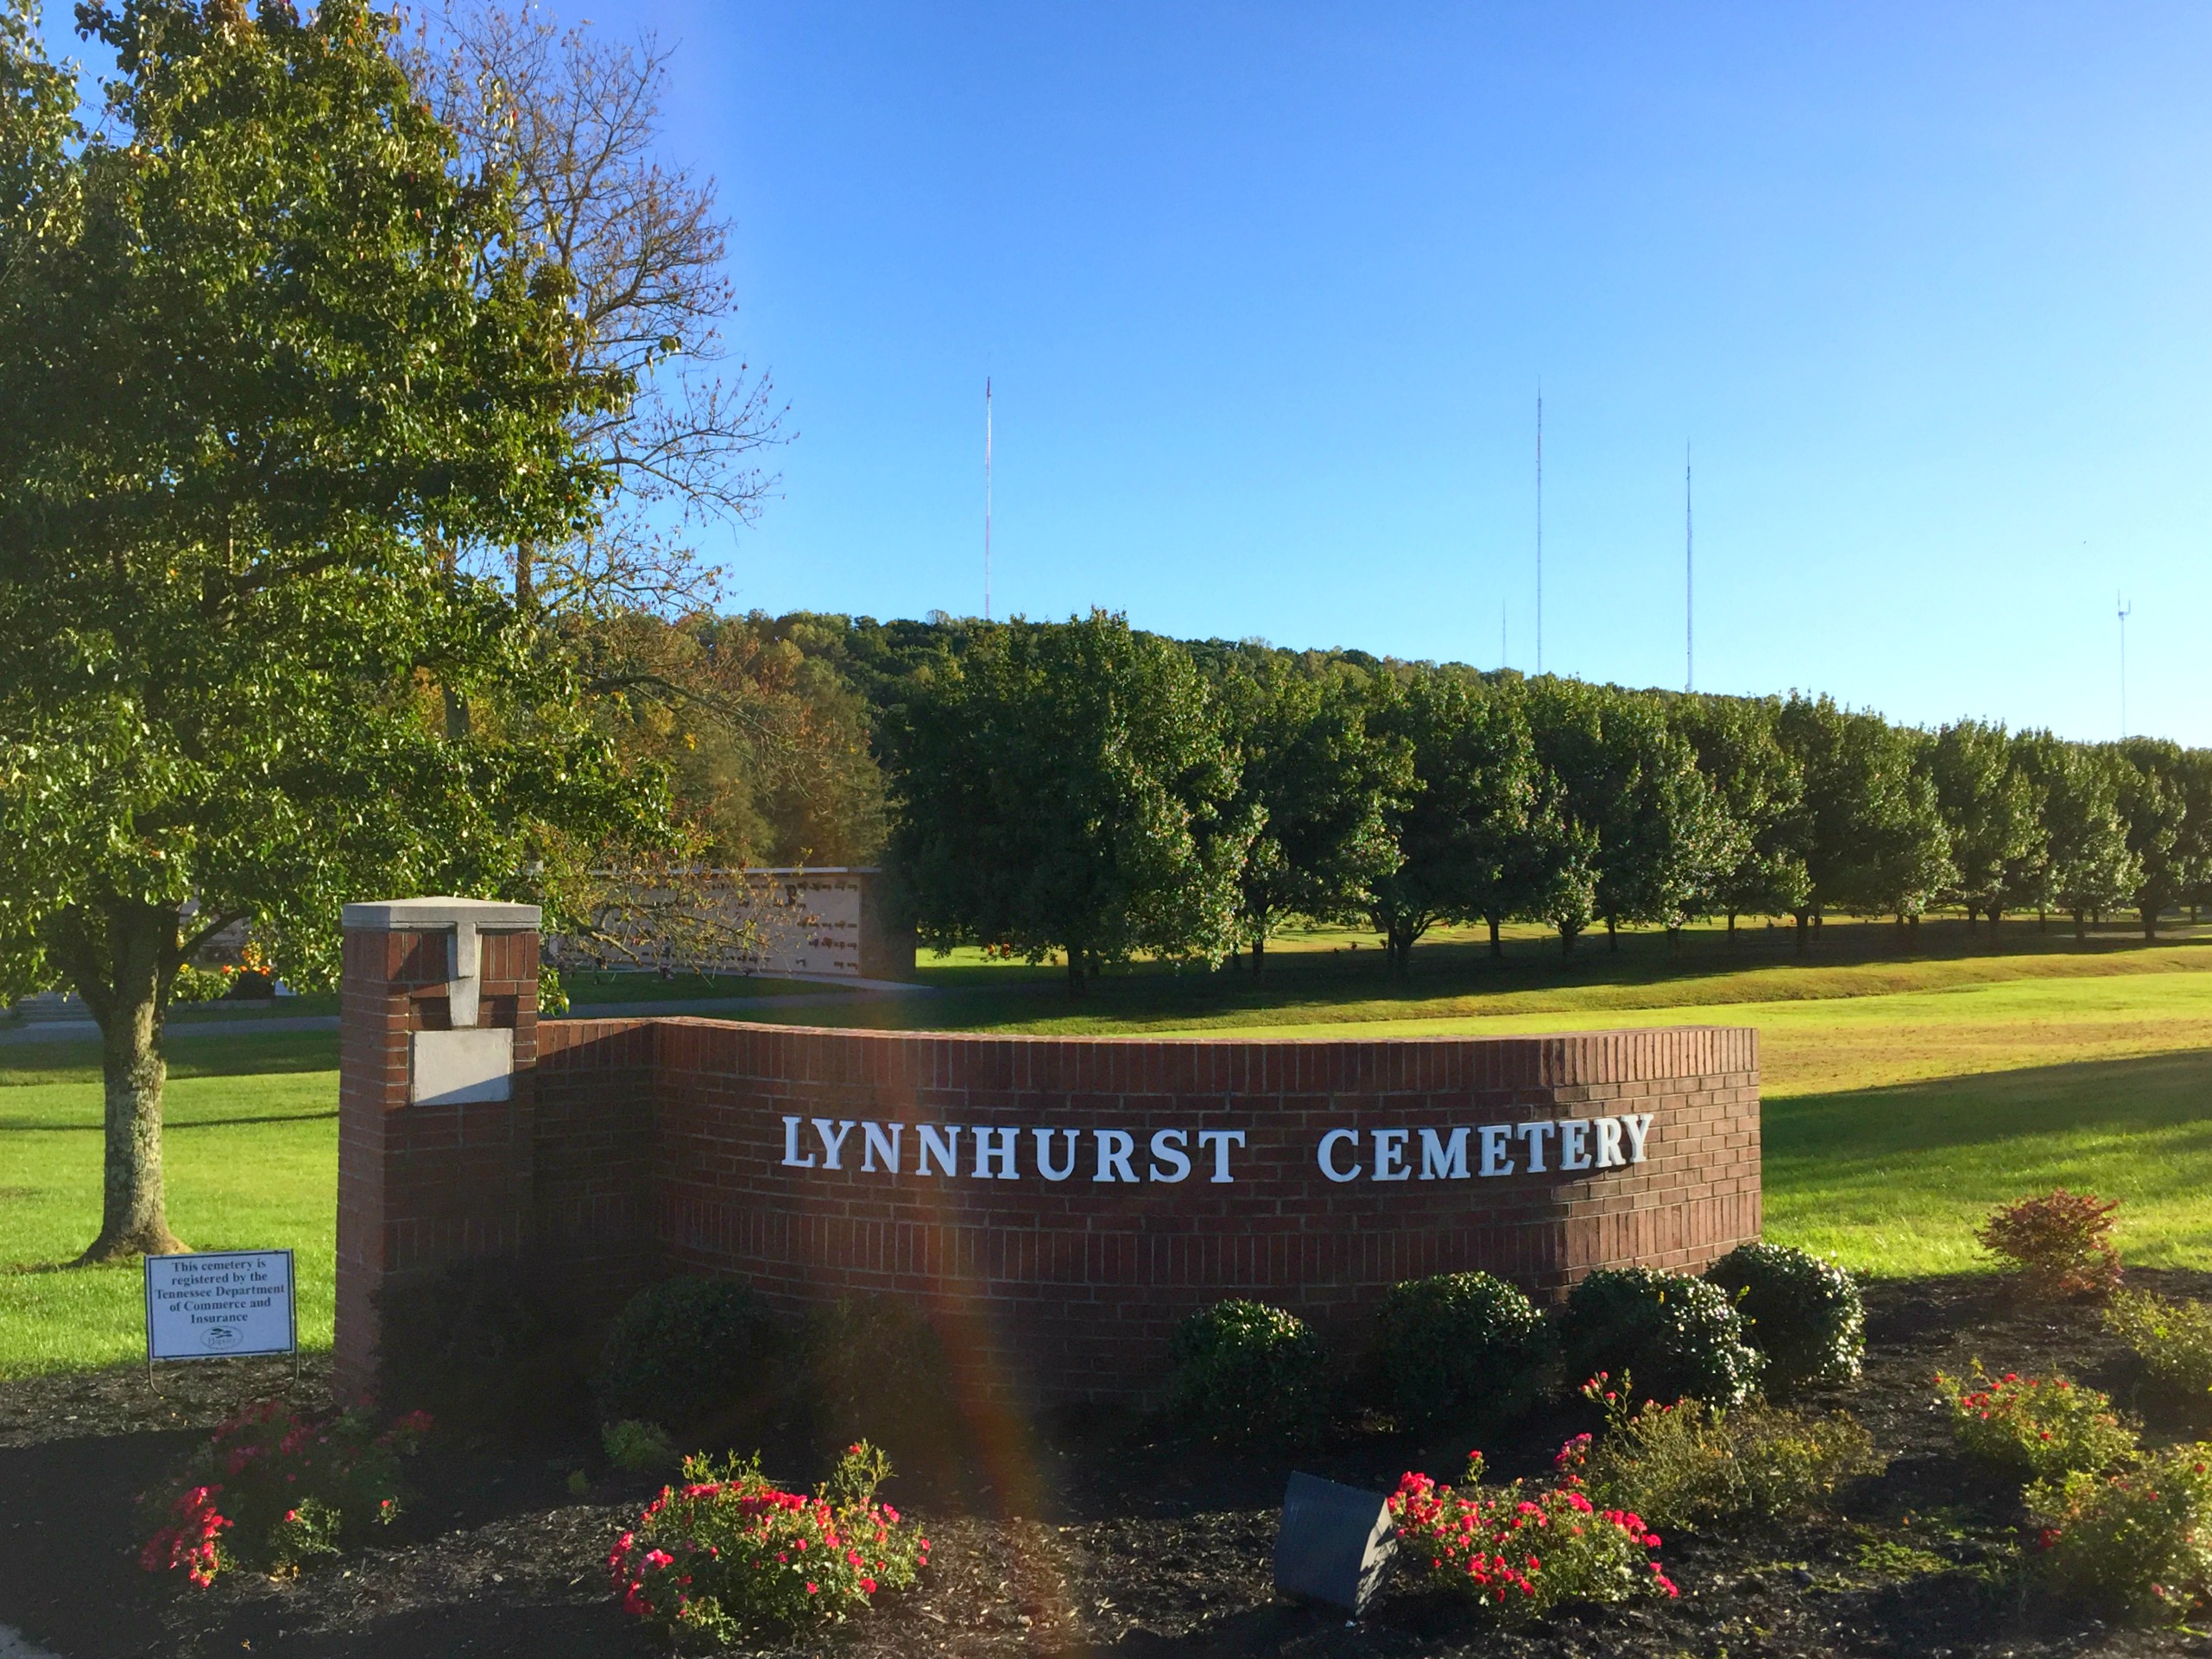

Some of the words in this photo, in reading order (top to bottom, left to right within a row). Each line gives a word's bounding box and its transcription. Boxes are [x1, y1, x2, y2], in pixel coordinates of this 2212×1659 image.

[781, 1115, 1246, 1184] LYNNHURST
[1317, 1113, 1654, 1183] CEMETERY
[172, 1262, 199, 1272] This
[201, 1260, 254, 1271] cemetery
[256, 1258, 267, 1268] is
[172, 1273, 229, 1287] registered
[232, 1273, 247, 1285] by
[250, 1271, 268, 1282] the
[155, 1288, 212, 1300] Tennessee
[216, 1284, 285, 1298] Department
[169, 1301, 181, 1312] of
[184, 1300, 247, 1311] Commerce
[250, 1297, 272, 1308] and
[190, 1313, 249, 1324] Insurance
